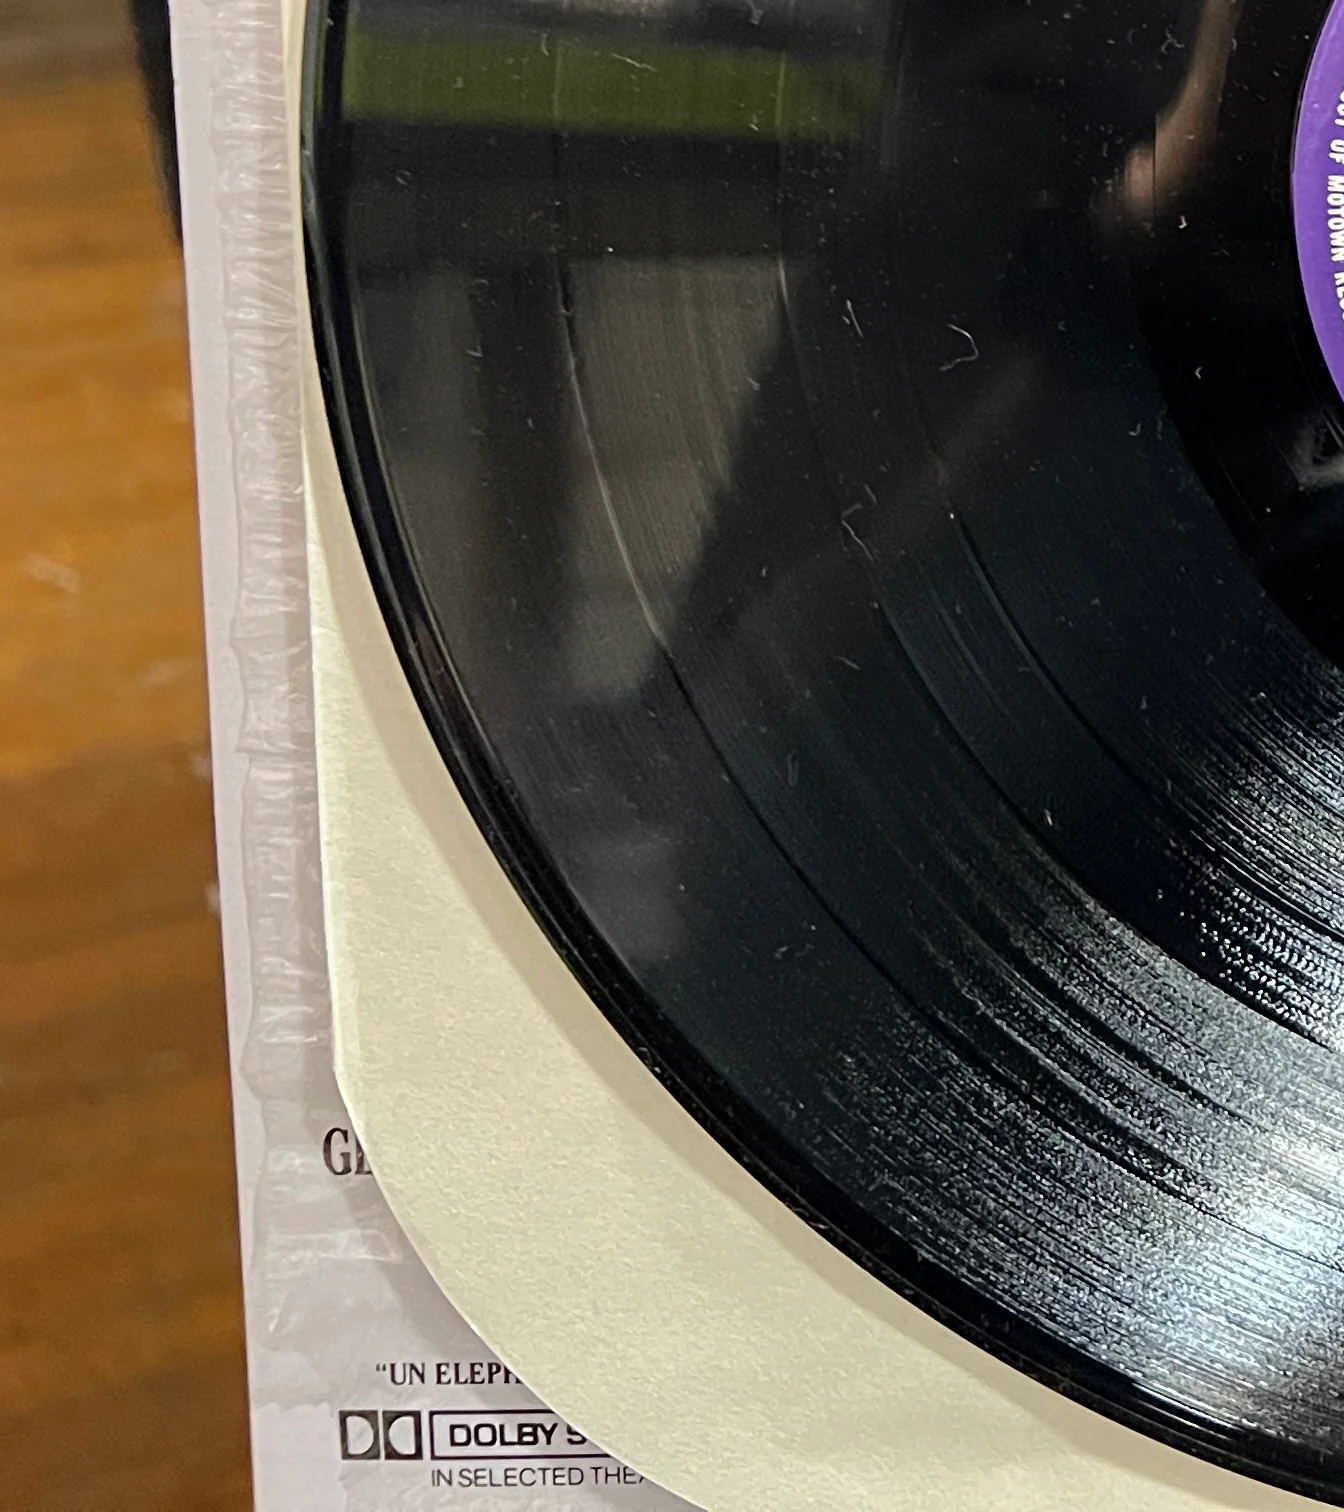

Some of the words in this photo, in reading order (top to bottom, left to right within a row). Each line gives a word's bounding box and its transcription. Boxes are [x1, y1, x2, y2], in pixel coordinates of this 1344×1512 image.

[450, 1423, 558, 1447] DOLBY
[431, 1469, 452, 1487] IN
[458, 1467, 584, 1487] SELECTED
